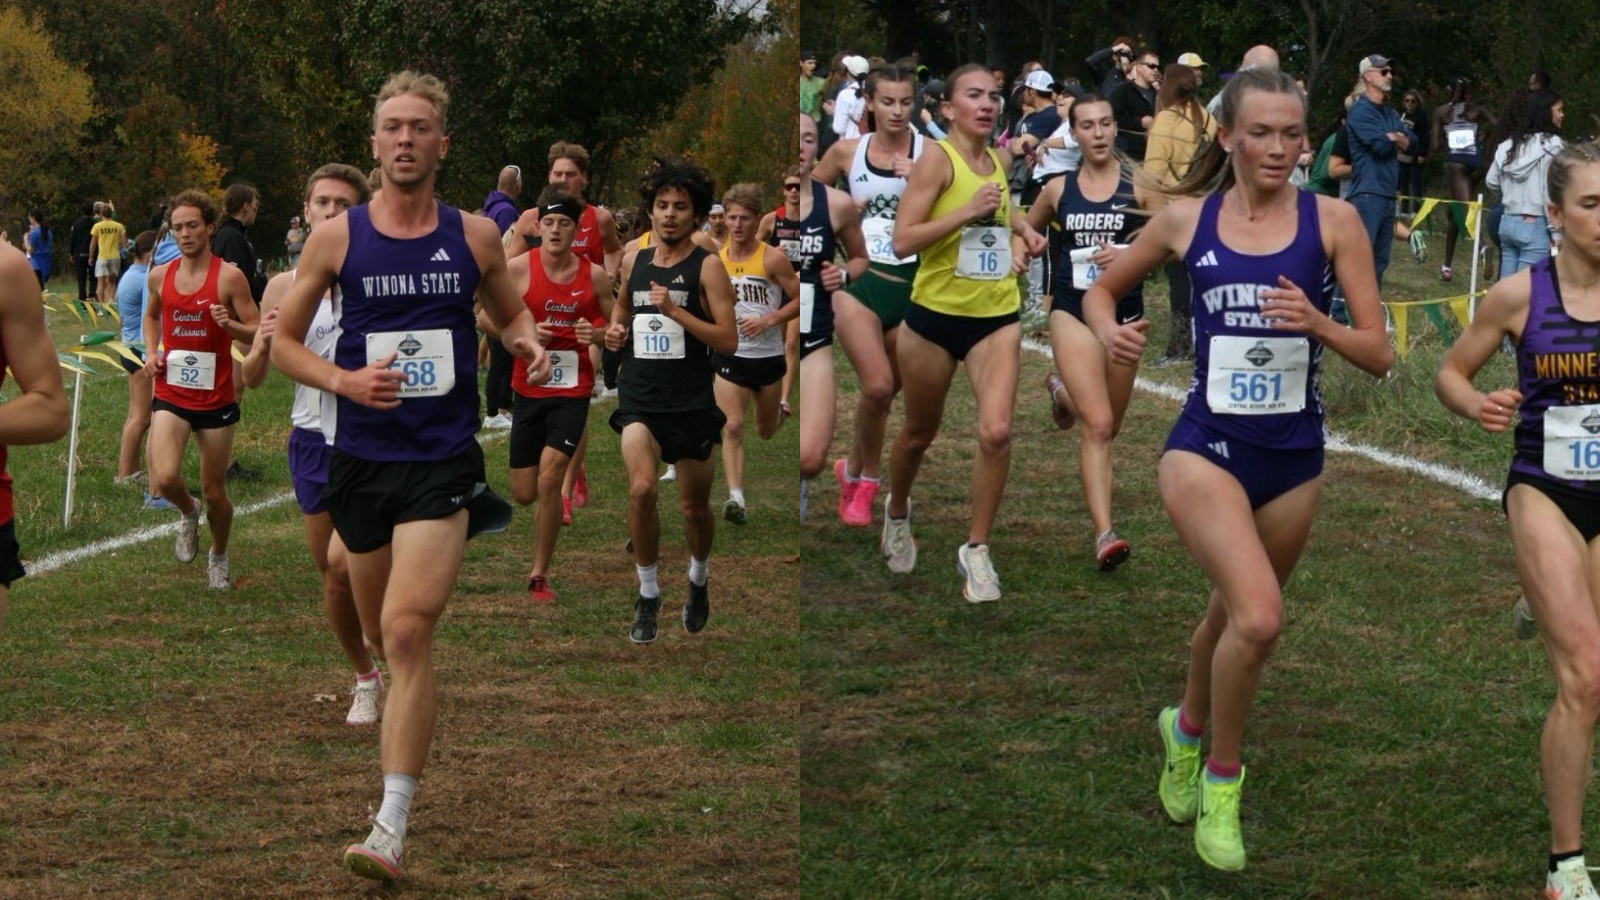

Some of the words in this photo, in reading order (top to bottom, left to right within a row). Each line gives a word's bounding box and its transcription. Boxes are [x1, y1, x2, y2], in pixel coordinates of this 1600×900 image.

[1066, 213, 1125, 231] ROGERS
[1075, 232, 1116, 246] STATE
[979, 251, 998, 272] 16
[362, 275, 416, 297] WINONA
[421, 272, 460, 294] STATE
[743, 283, 769, 305] STATE
[545, 299, 578, 313] Central
[173, 309, 203, 322] Central
[171, 325, 208, 338] Missouri
[644, 335, 670, 352] 110
[1535, 353, 1600, 379] MINNE
[181, 368, 199, 383] 52
[1229, 372, 1282, 402] 561
